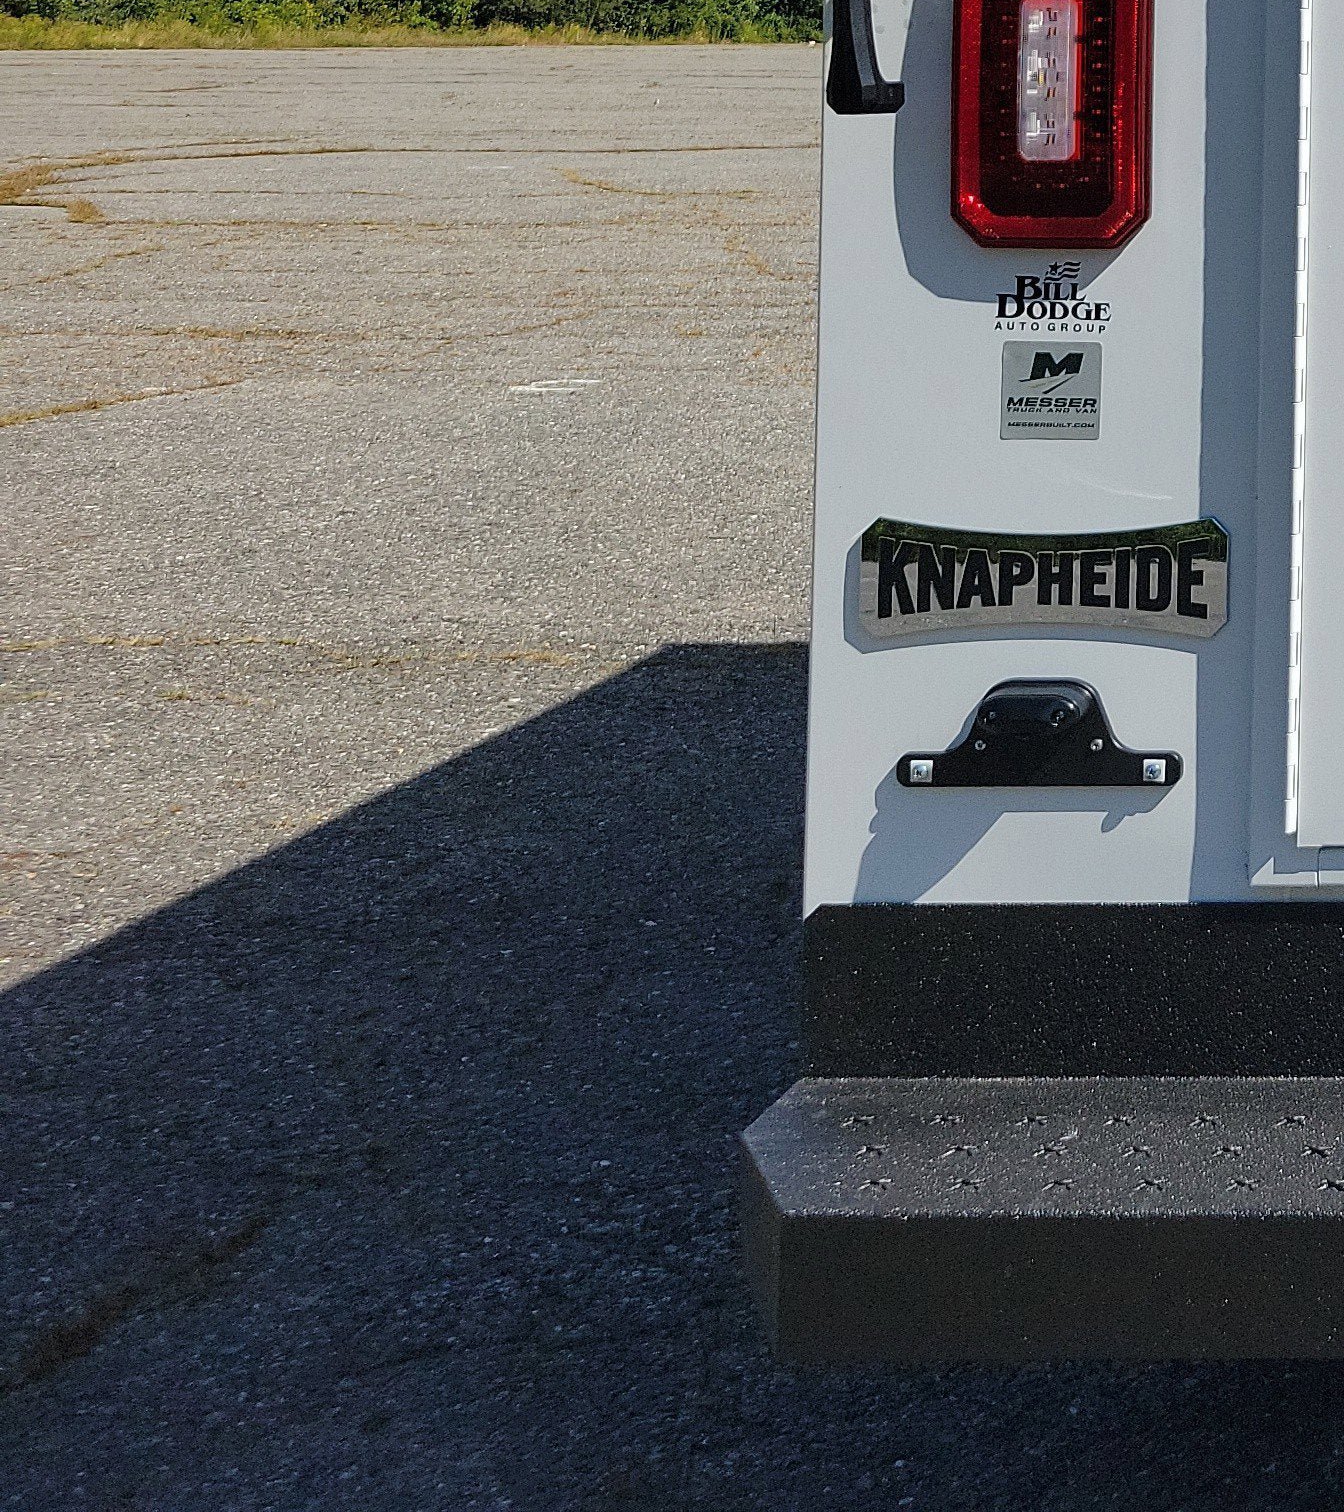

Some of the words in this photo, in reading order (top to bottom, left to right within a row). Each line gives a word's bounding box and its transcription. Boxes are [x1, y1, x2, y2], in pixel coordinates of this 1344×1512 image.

[1015, 275, 1087, 301] BILL
[995, 293, 1112, 322] DODGE
[994, 321, 1040, 331] AUTO
[1047, 322, 1106, 334] GROUP
[1006, 396, 1098, 408] MESSER
[877, 536, 1210, 620] KNAPHEIDE
